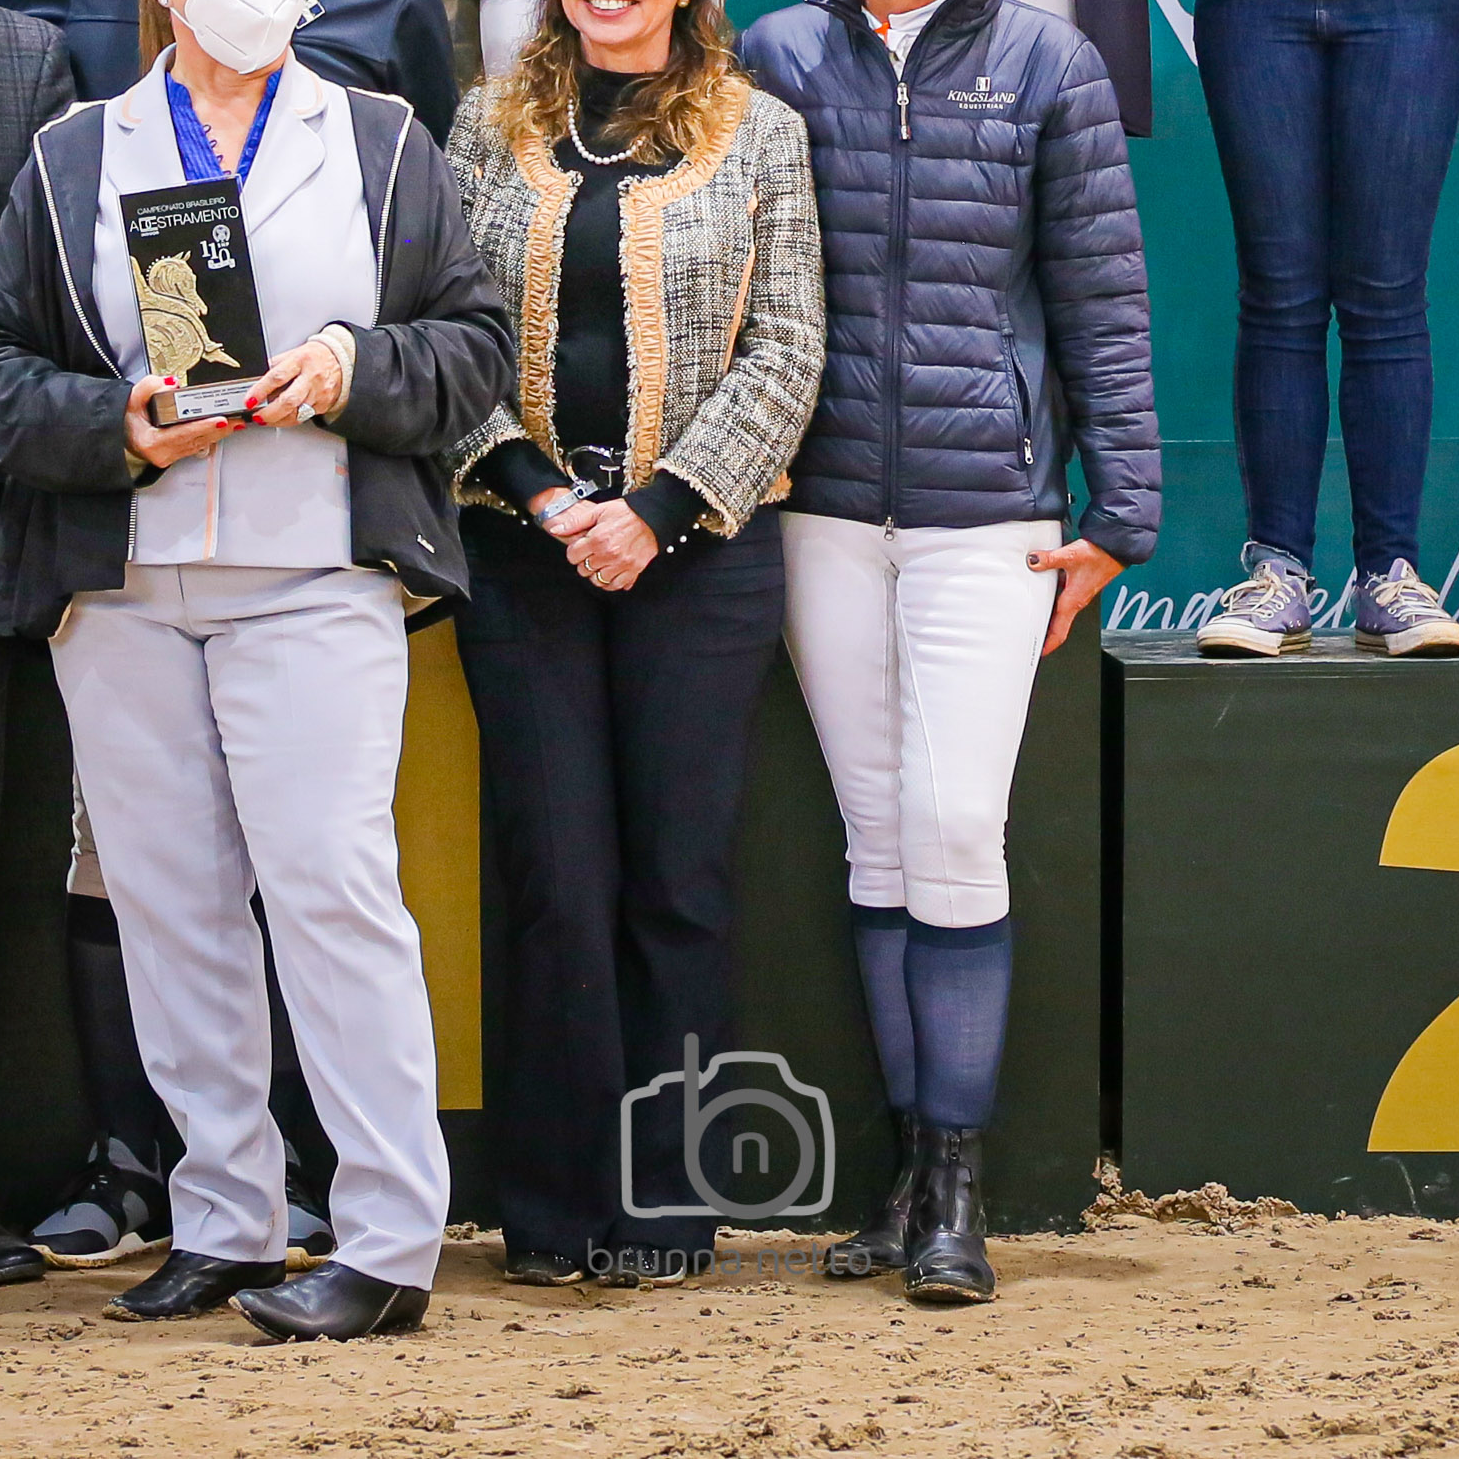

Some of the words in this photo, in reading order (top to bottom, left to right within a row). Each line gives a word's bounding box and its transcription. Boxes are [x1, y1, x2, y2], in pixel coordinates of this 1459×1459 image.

[947, 90, 1016, 104] KINGSLAND
[137, 202, 185, 215] CAMPEONATO
[129, 206, 239, 233] ADESTRAMENTO
